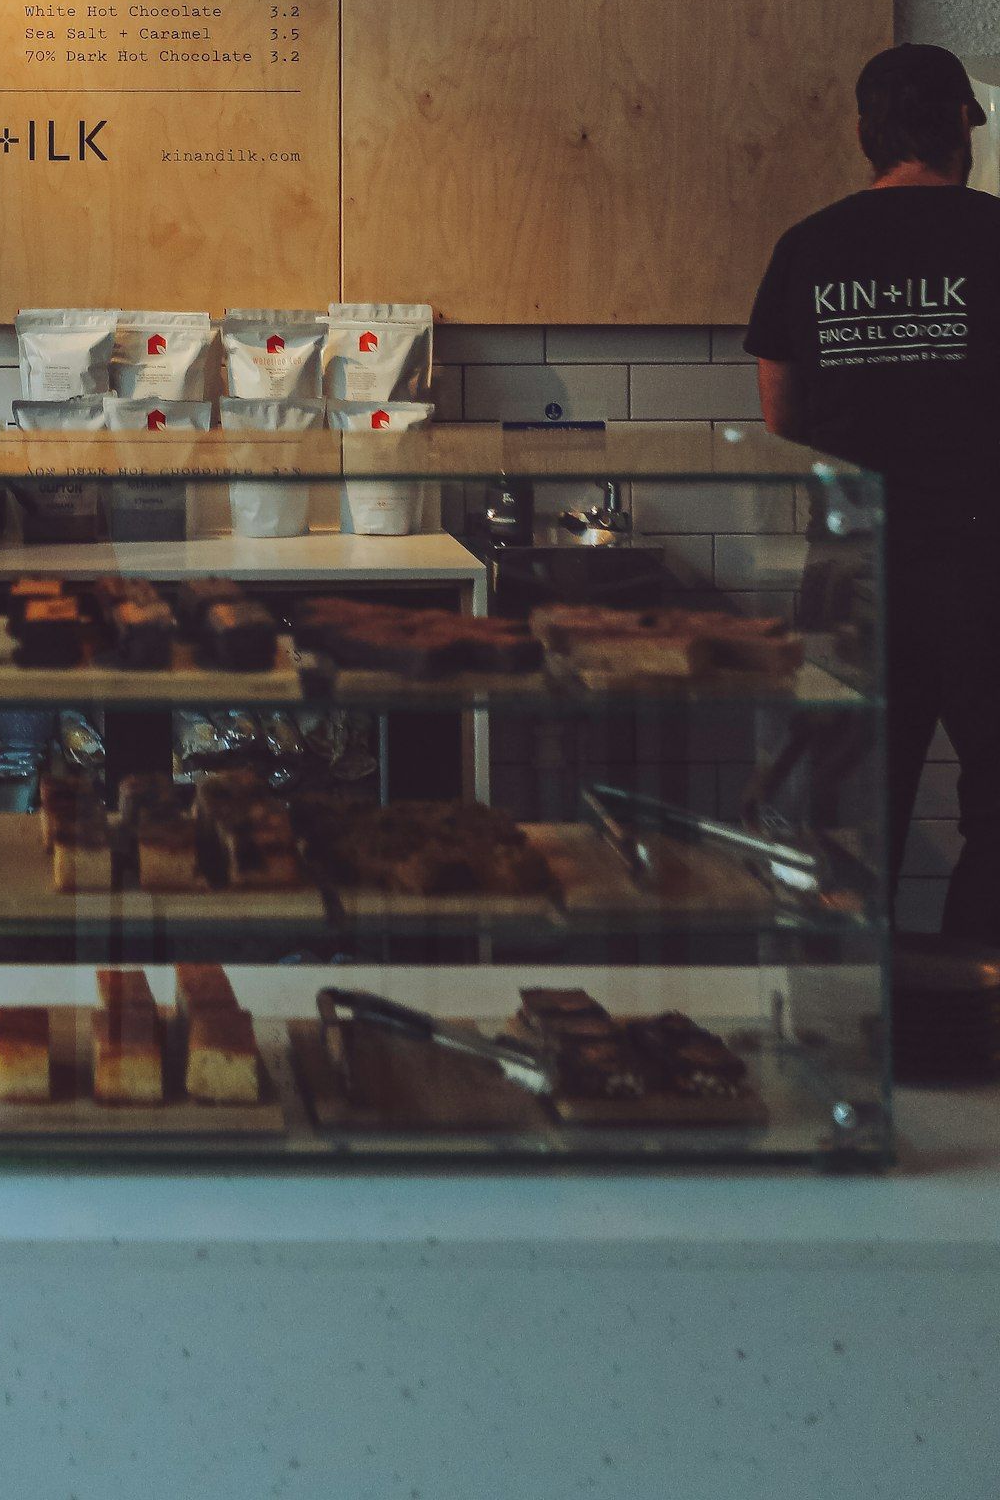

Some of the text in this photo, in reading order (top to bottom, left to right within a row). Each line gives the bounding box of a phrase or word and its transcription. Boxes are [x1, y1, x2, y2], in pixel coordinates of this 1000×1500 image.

[25, 5, 299, 18] White Hot Chocolate 3.2
[26, 29, 55, 39] Sea
[68, 28, 107, 39] Salt
[140, 28, 210, 39] Caramel
[271, 29, 299, 40] 3.5
[26, 50, 299, 63] 70% Dark Hot Chocolate 3.2
[162, 149, 300, 161] kinandilk.com
[818, 327, 863, 344] FINCA
[867, 325, 886, 339] EL
